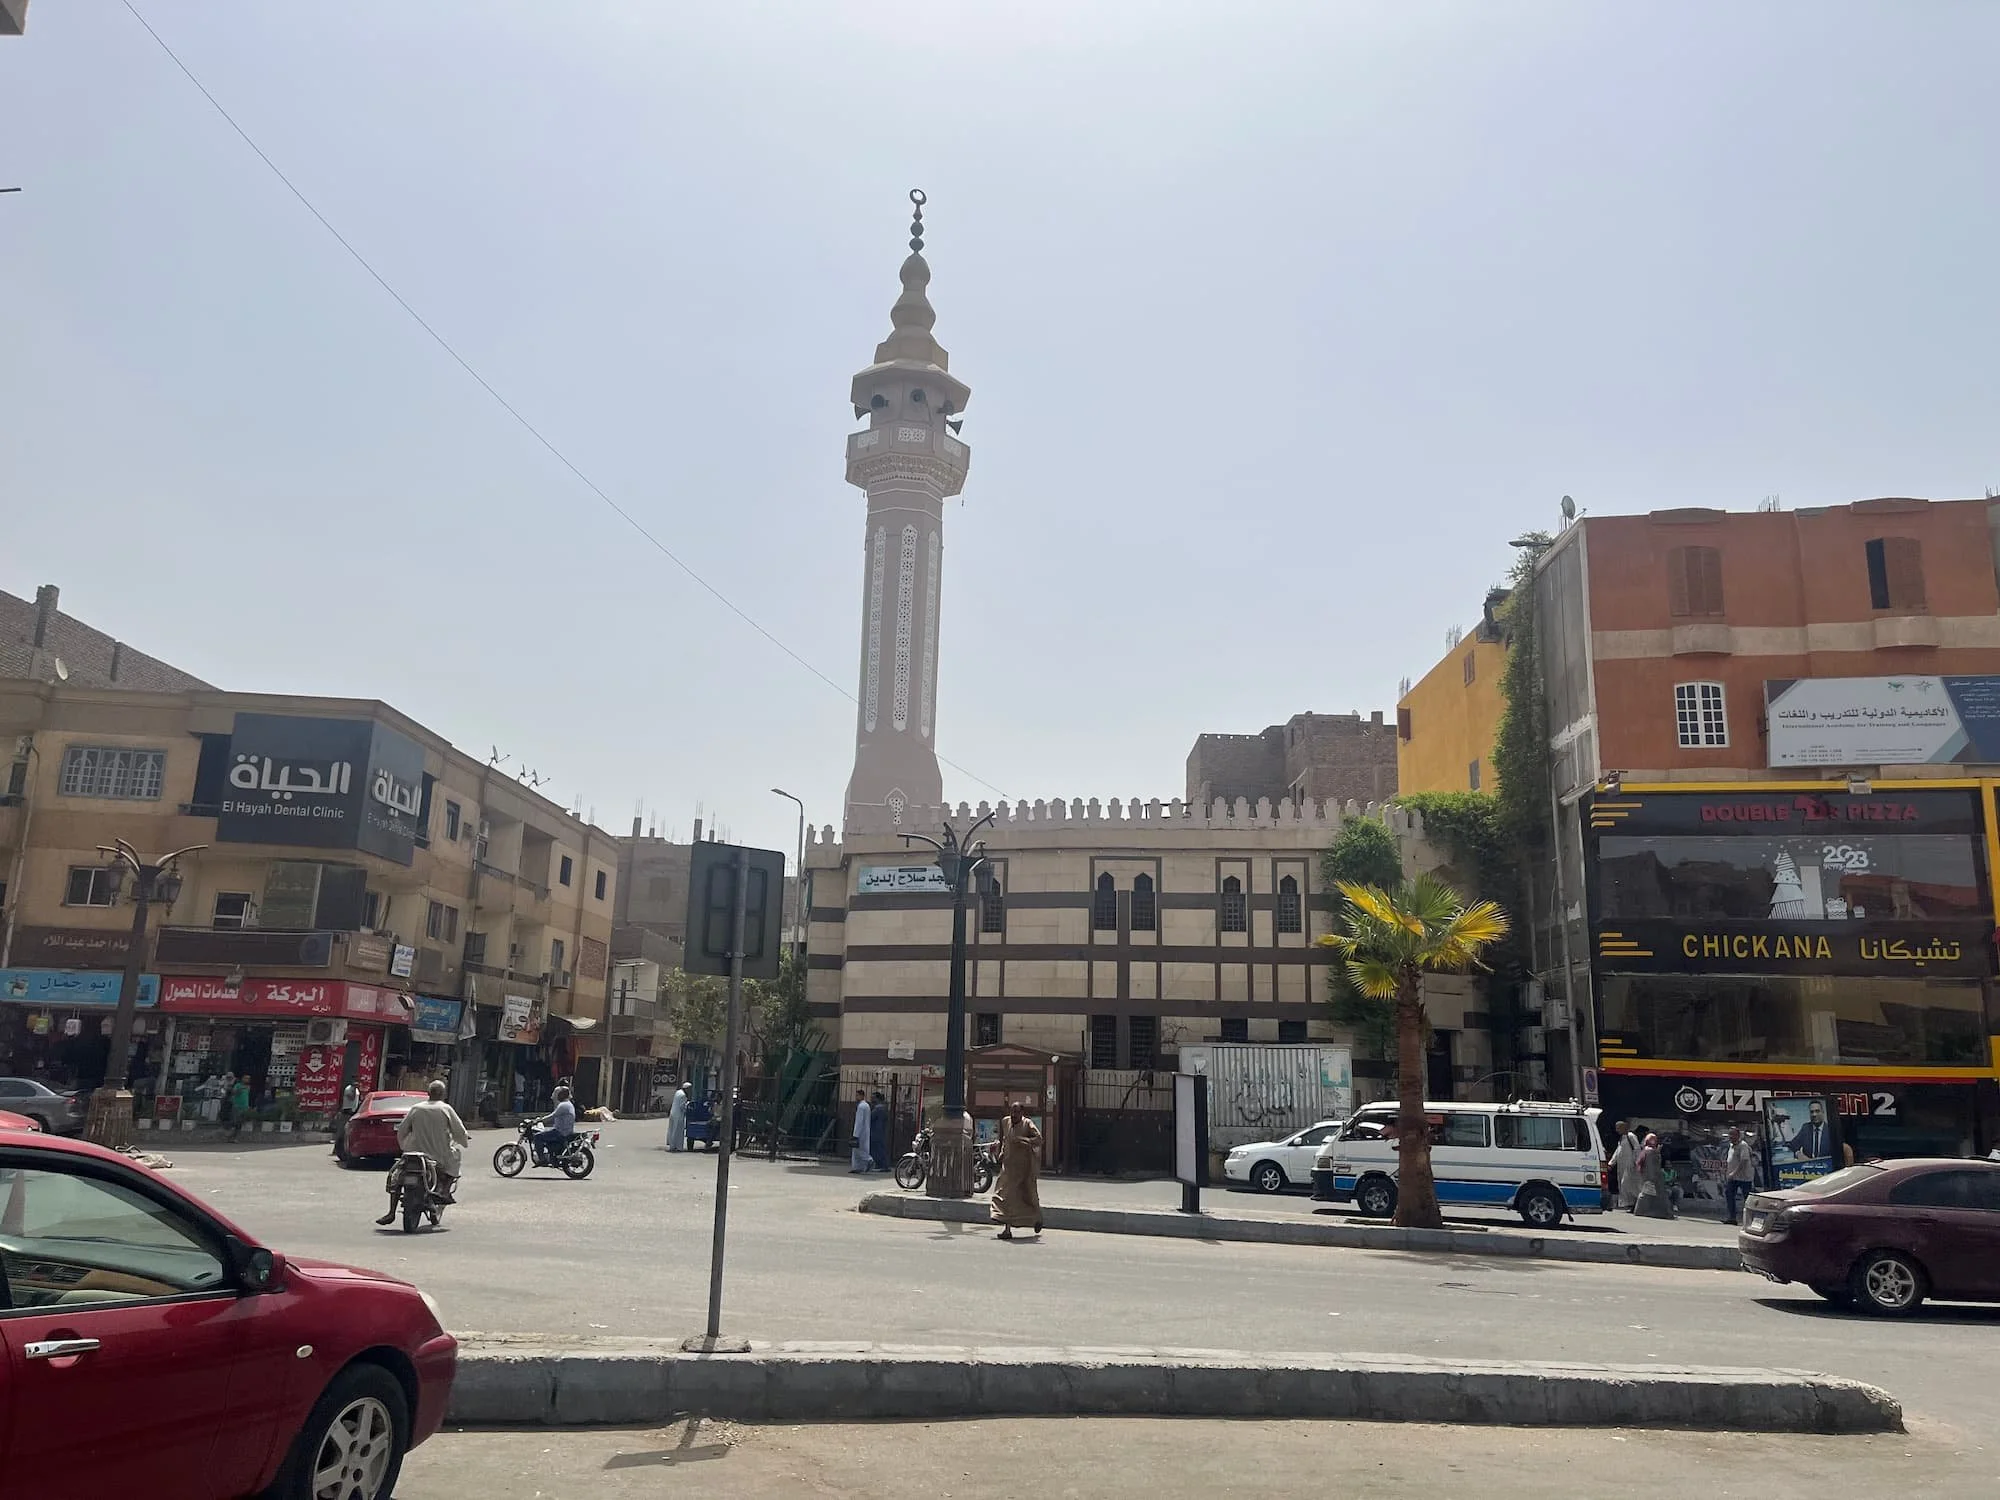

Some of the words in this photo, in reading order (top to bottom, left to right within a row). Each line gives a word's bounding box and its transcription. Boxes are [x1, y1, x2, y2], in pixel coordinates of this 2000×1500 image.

[1819, 708, 1859, 720] للتدريب
[1862, 707, 1897, 720] الدولية
[1900, 707, 1949, 718] الأكاديمية
[230, 754, 351, 800] الحياة
[373, 768, 422, 817] الحياة
[222, 801, 234, 812] El
[236, 802, 272, 815] Hayah
[274, 804, 311, 816] Dental
[312, 807, 345, 819] Clinic
[1700, 804, 1791, 822] DOUBLE
[1846, 804, 1920, 821] PIZZA
[1823, 845, 1869, 868] 2023
[866, 873, 895, 886] الدين
[897, 873, 926, 885] صلاح
[1683, 935, 1832, 959] CHICKANA
[1860, 937, 1960, 966] تشيكانا
[40, 977, 82, 992] جمال
[165, 983, 202, 1002] المحمول
[266, 984, 324, 1006] البركة
[1872, 1092, 1897, 1115] 2
